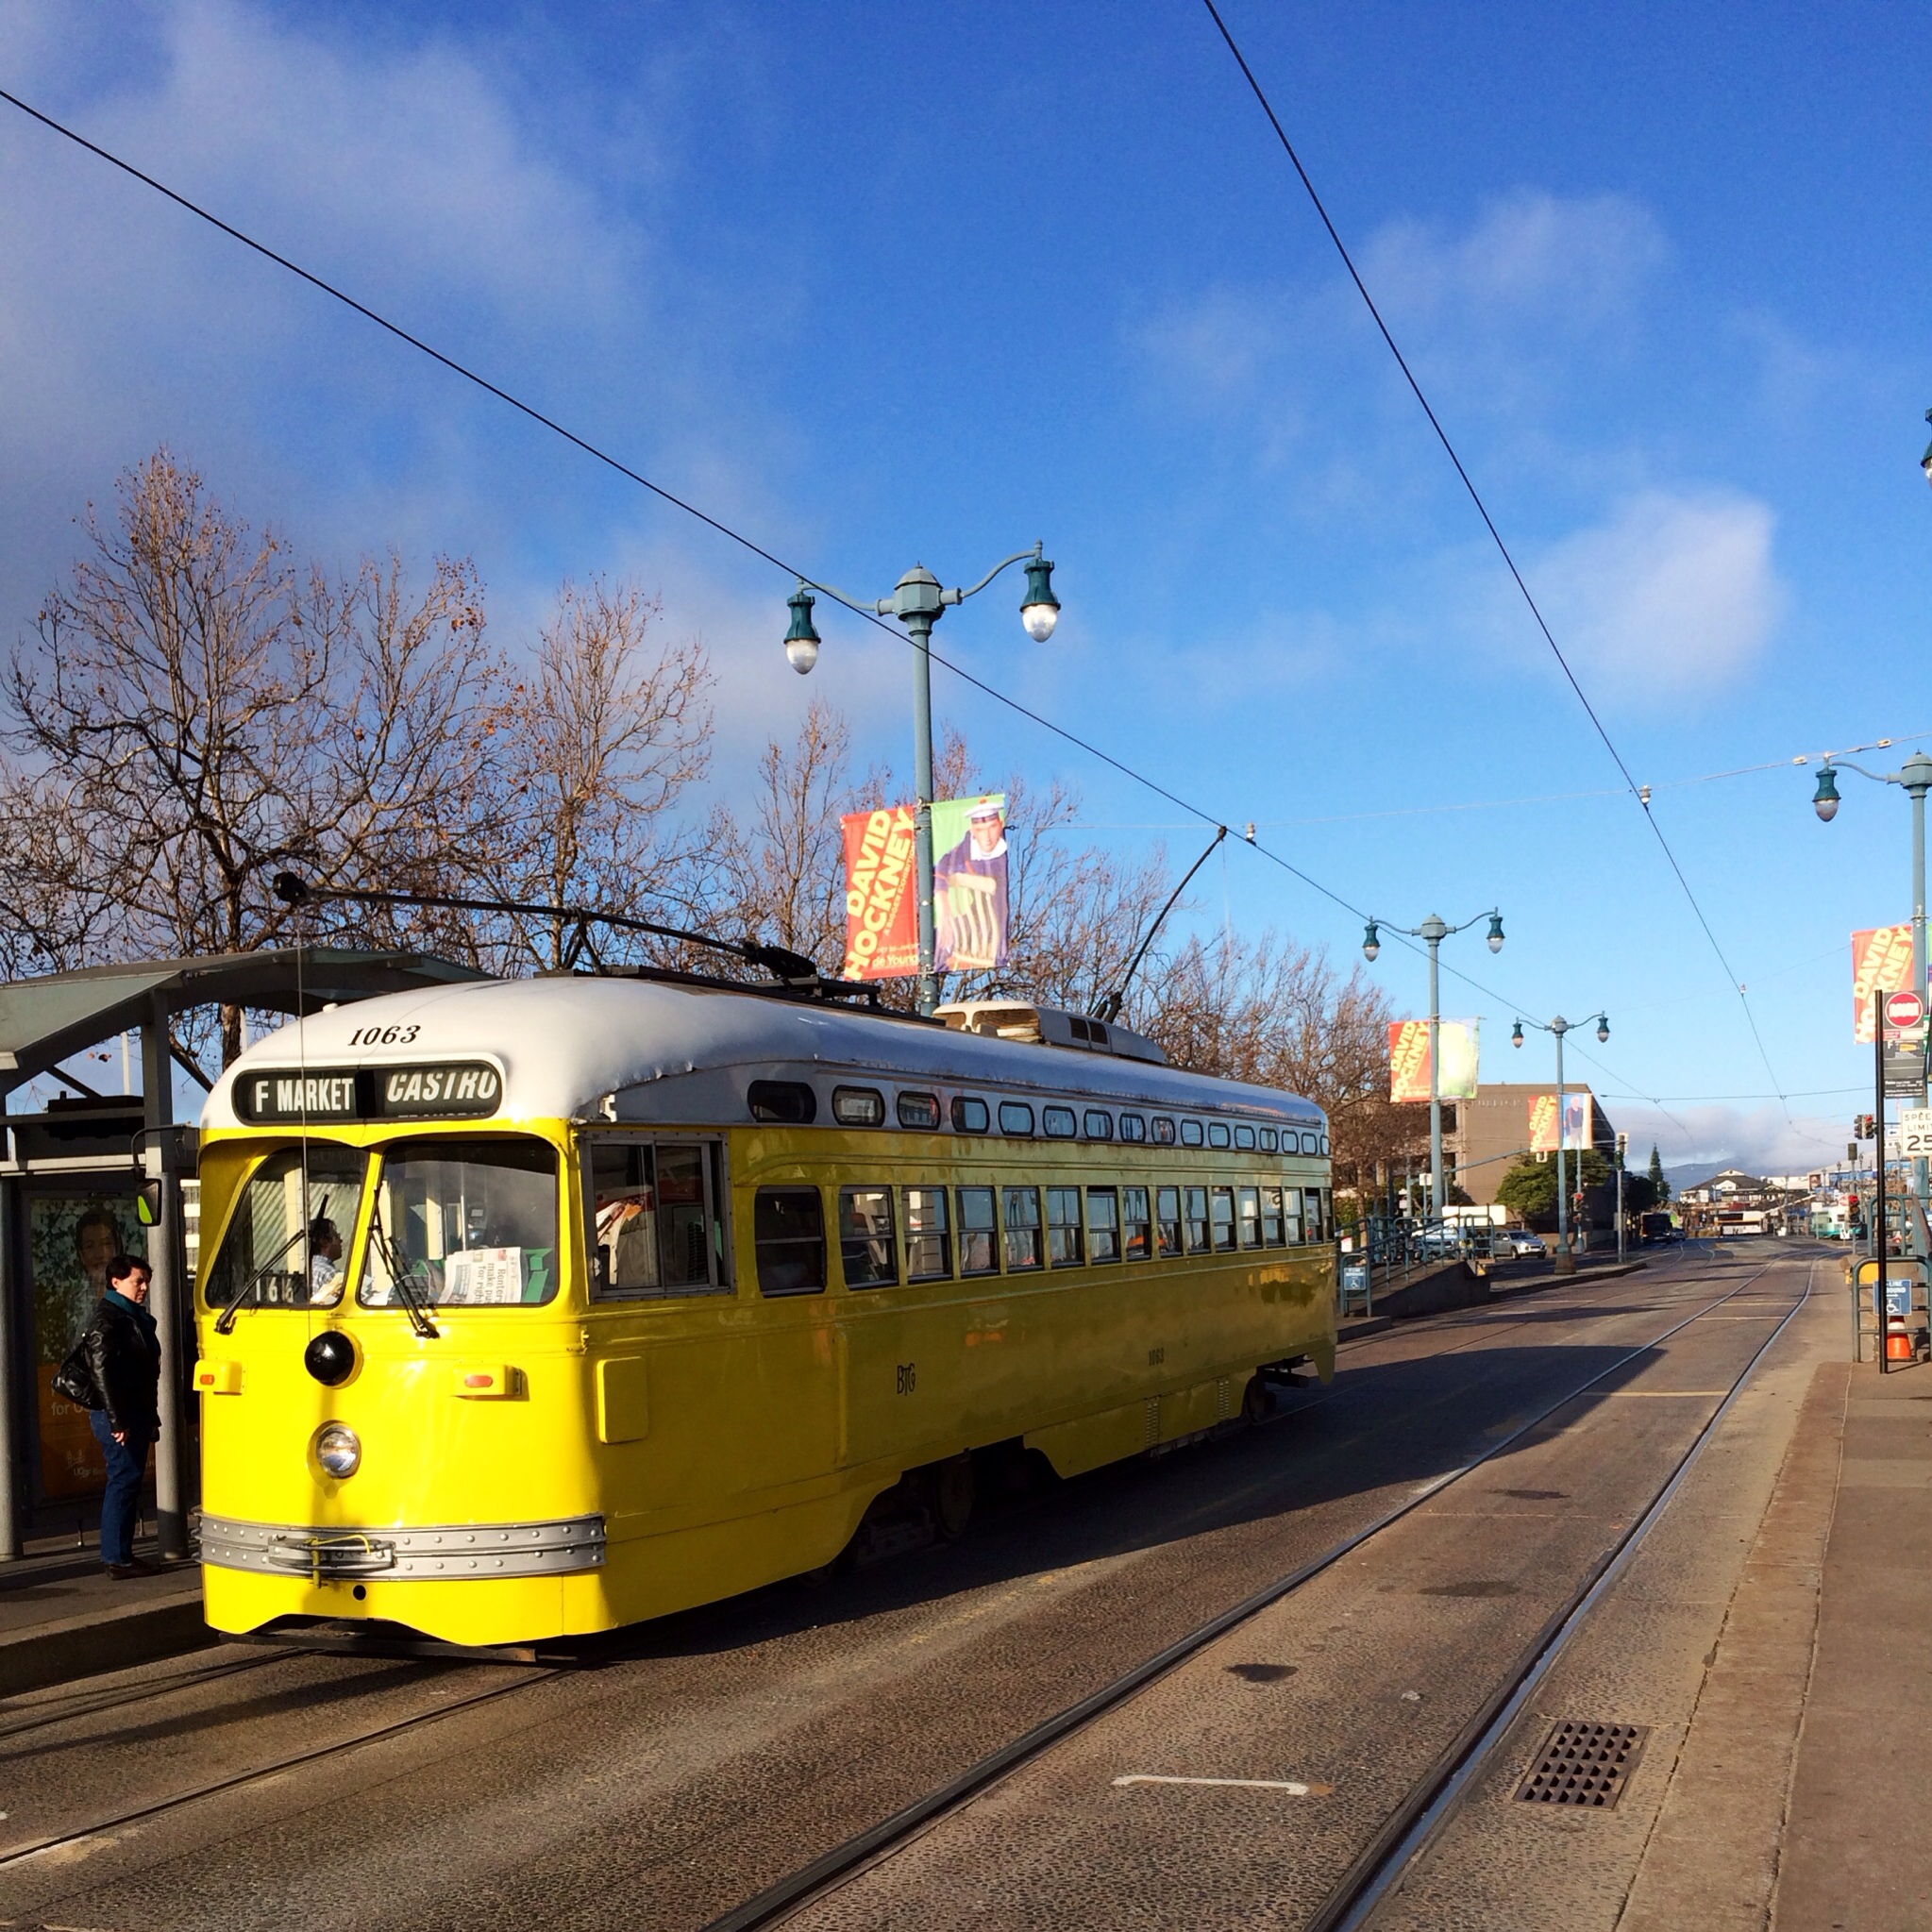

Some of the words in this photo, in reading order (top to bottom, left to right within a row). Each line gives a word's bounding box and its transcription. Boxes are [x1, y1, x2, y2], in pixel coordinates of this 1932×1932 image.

[847, 810, 891, 918] DAVID
[843, 807, 915, 981] HOCKNEY
[872, 956, 885, 967] de
[884, 953, 918, 966] Young
[1854, 928, 1892, 1000] DAVID
[347, 1025, 421, 1047] 1063
[1390, 1021, 1417, 1072] DAVID
[1390, 1021, 1430, 1103] HOCKNEY
[255, 1081, 269, 1113] F
[277, 1078, 354, 1112] MARKET
[387, 1071, 497, 1102] CASTRO
[1529, 1096, 1548, 1132] DAVID
[1530, 1095, 1557, 1152] HOCKNEY
[1907, 1134, 1932, 1151] 25
[478, 1266, 486, 1280] for
[486, 1263, 496, 1287] make
[51, 1402, 69, 1416] for
